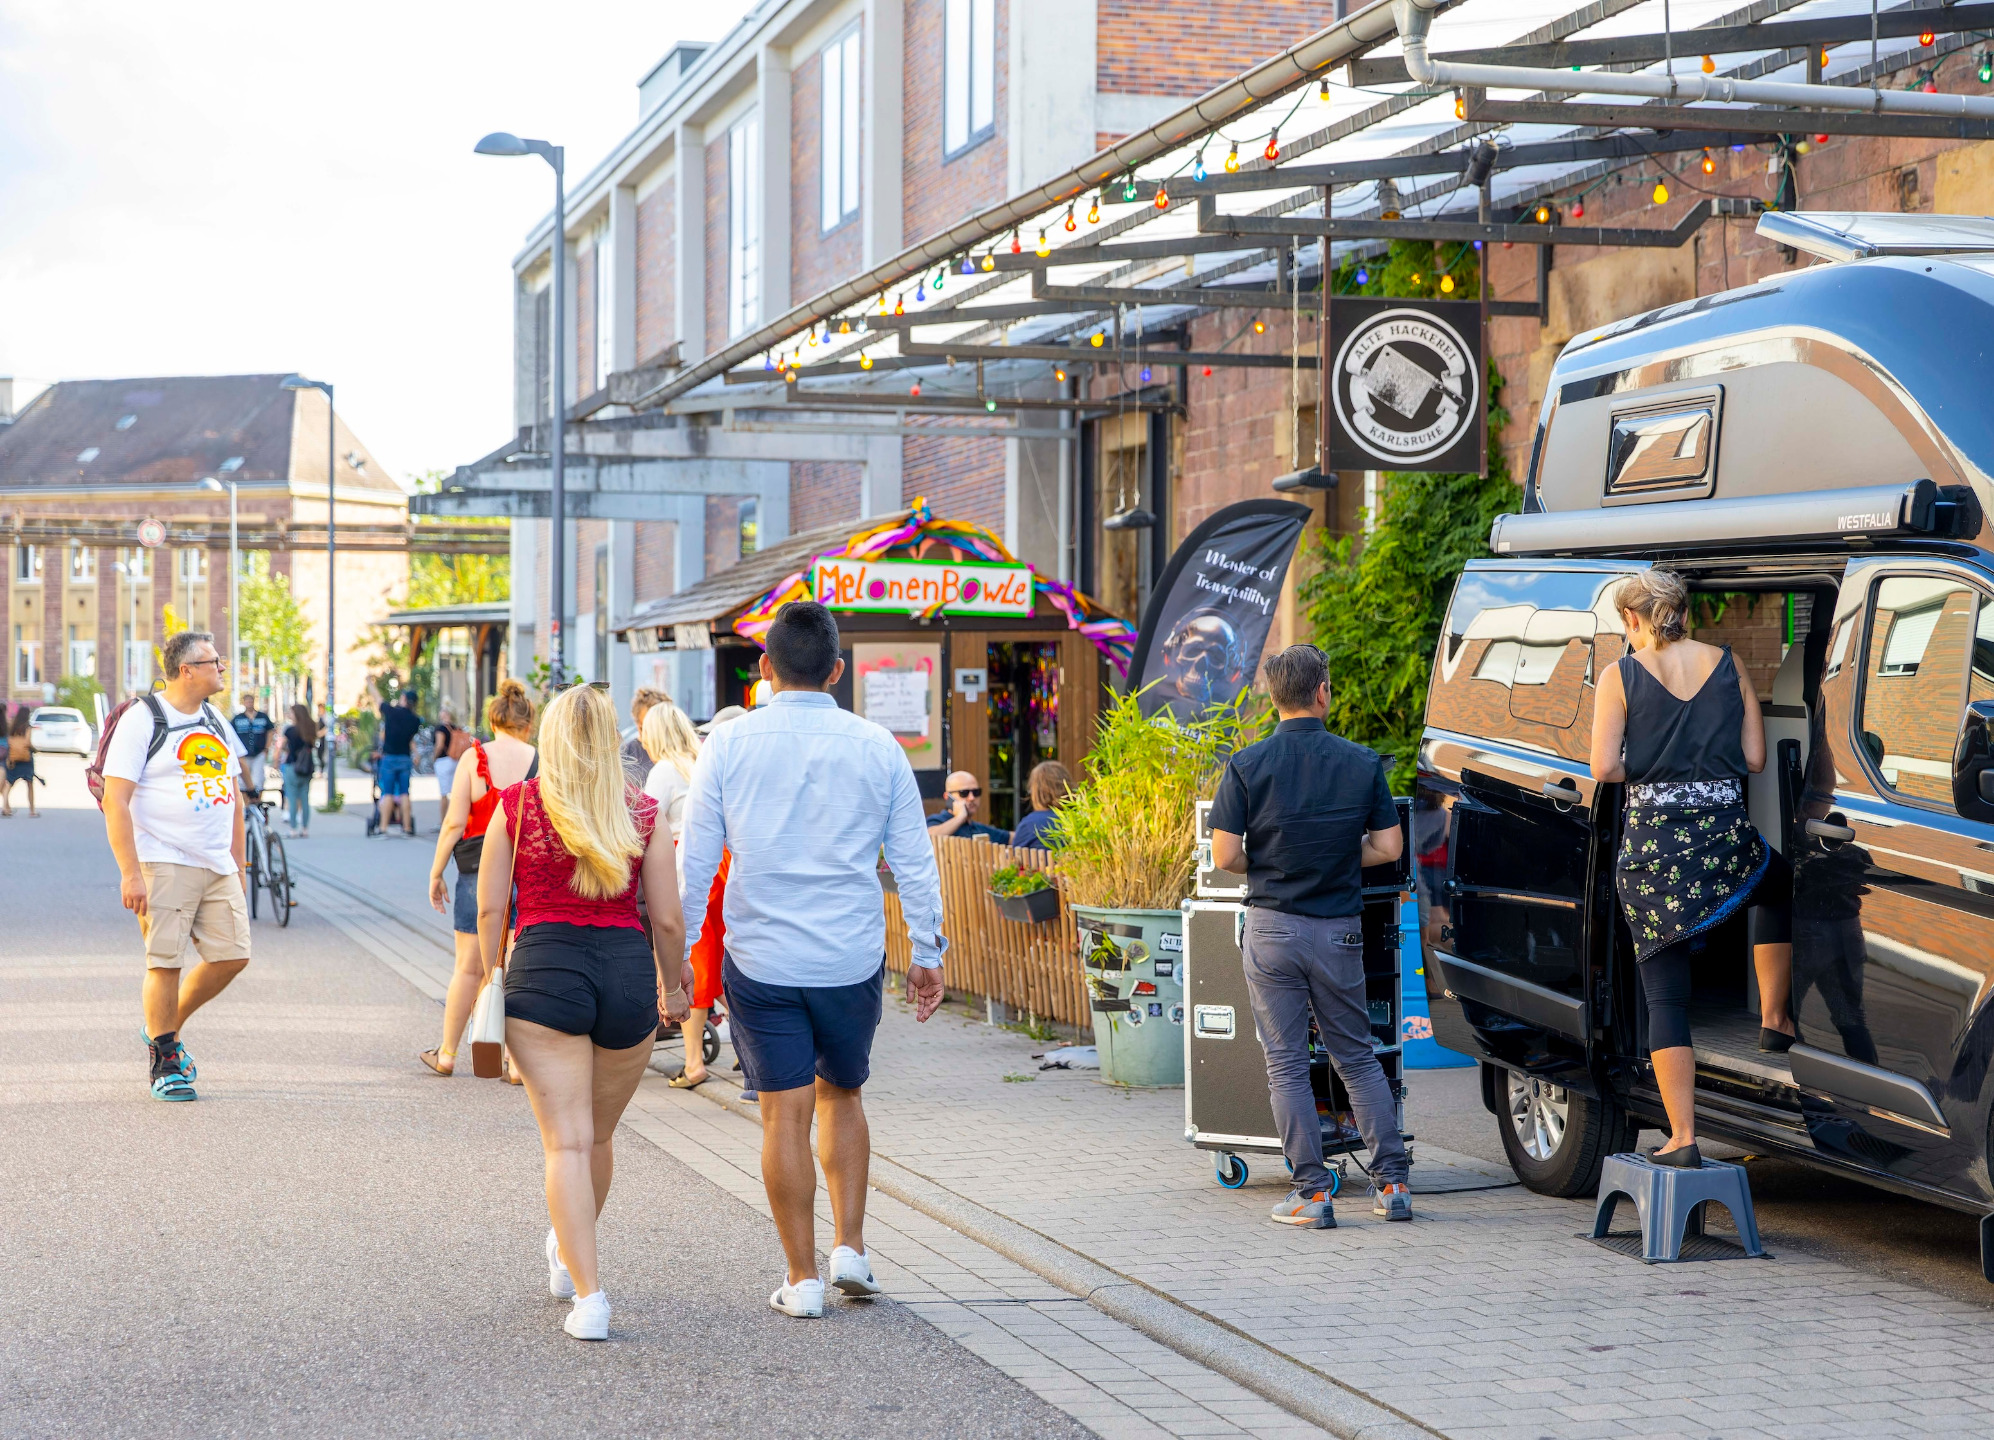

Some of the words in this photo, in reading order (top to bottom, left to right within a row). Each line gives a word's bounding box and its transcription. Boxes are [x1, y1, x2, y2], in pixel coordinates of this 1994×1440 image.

[1355, 329, 1384, 360] ALTE
[1390, 325, 1457, 361] HACKEREI
[1369, 424, 1444, 447] KARLSRUHE
[1837, 512, 1892, 530] WESTFALIA
[1205, 549, 1258, 576] Master
[1258, 565, 1278, 581] of
[1195, 572, 1271, 615] Tranquility
